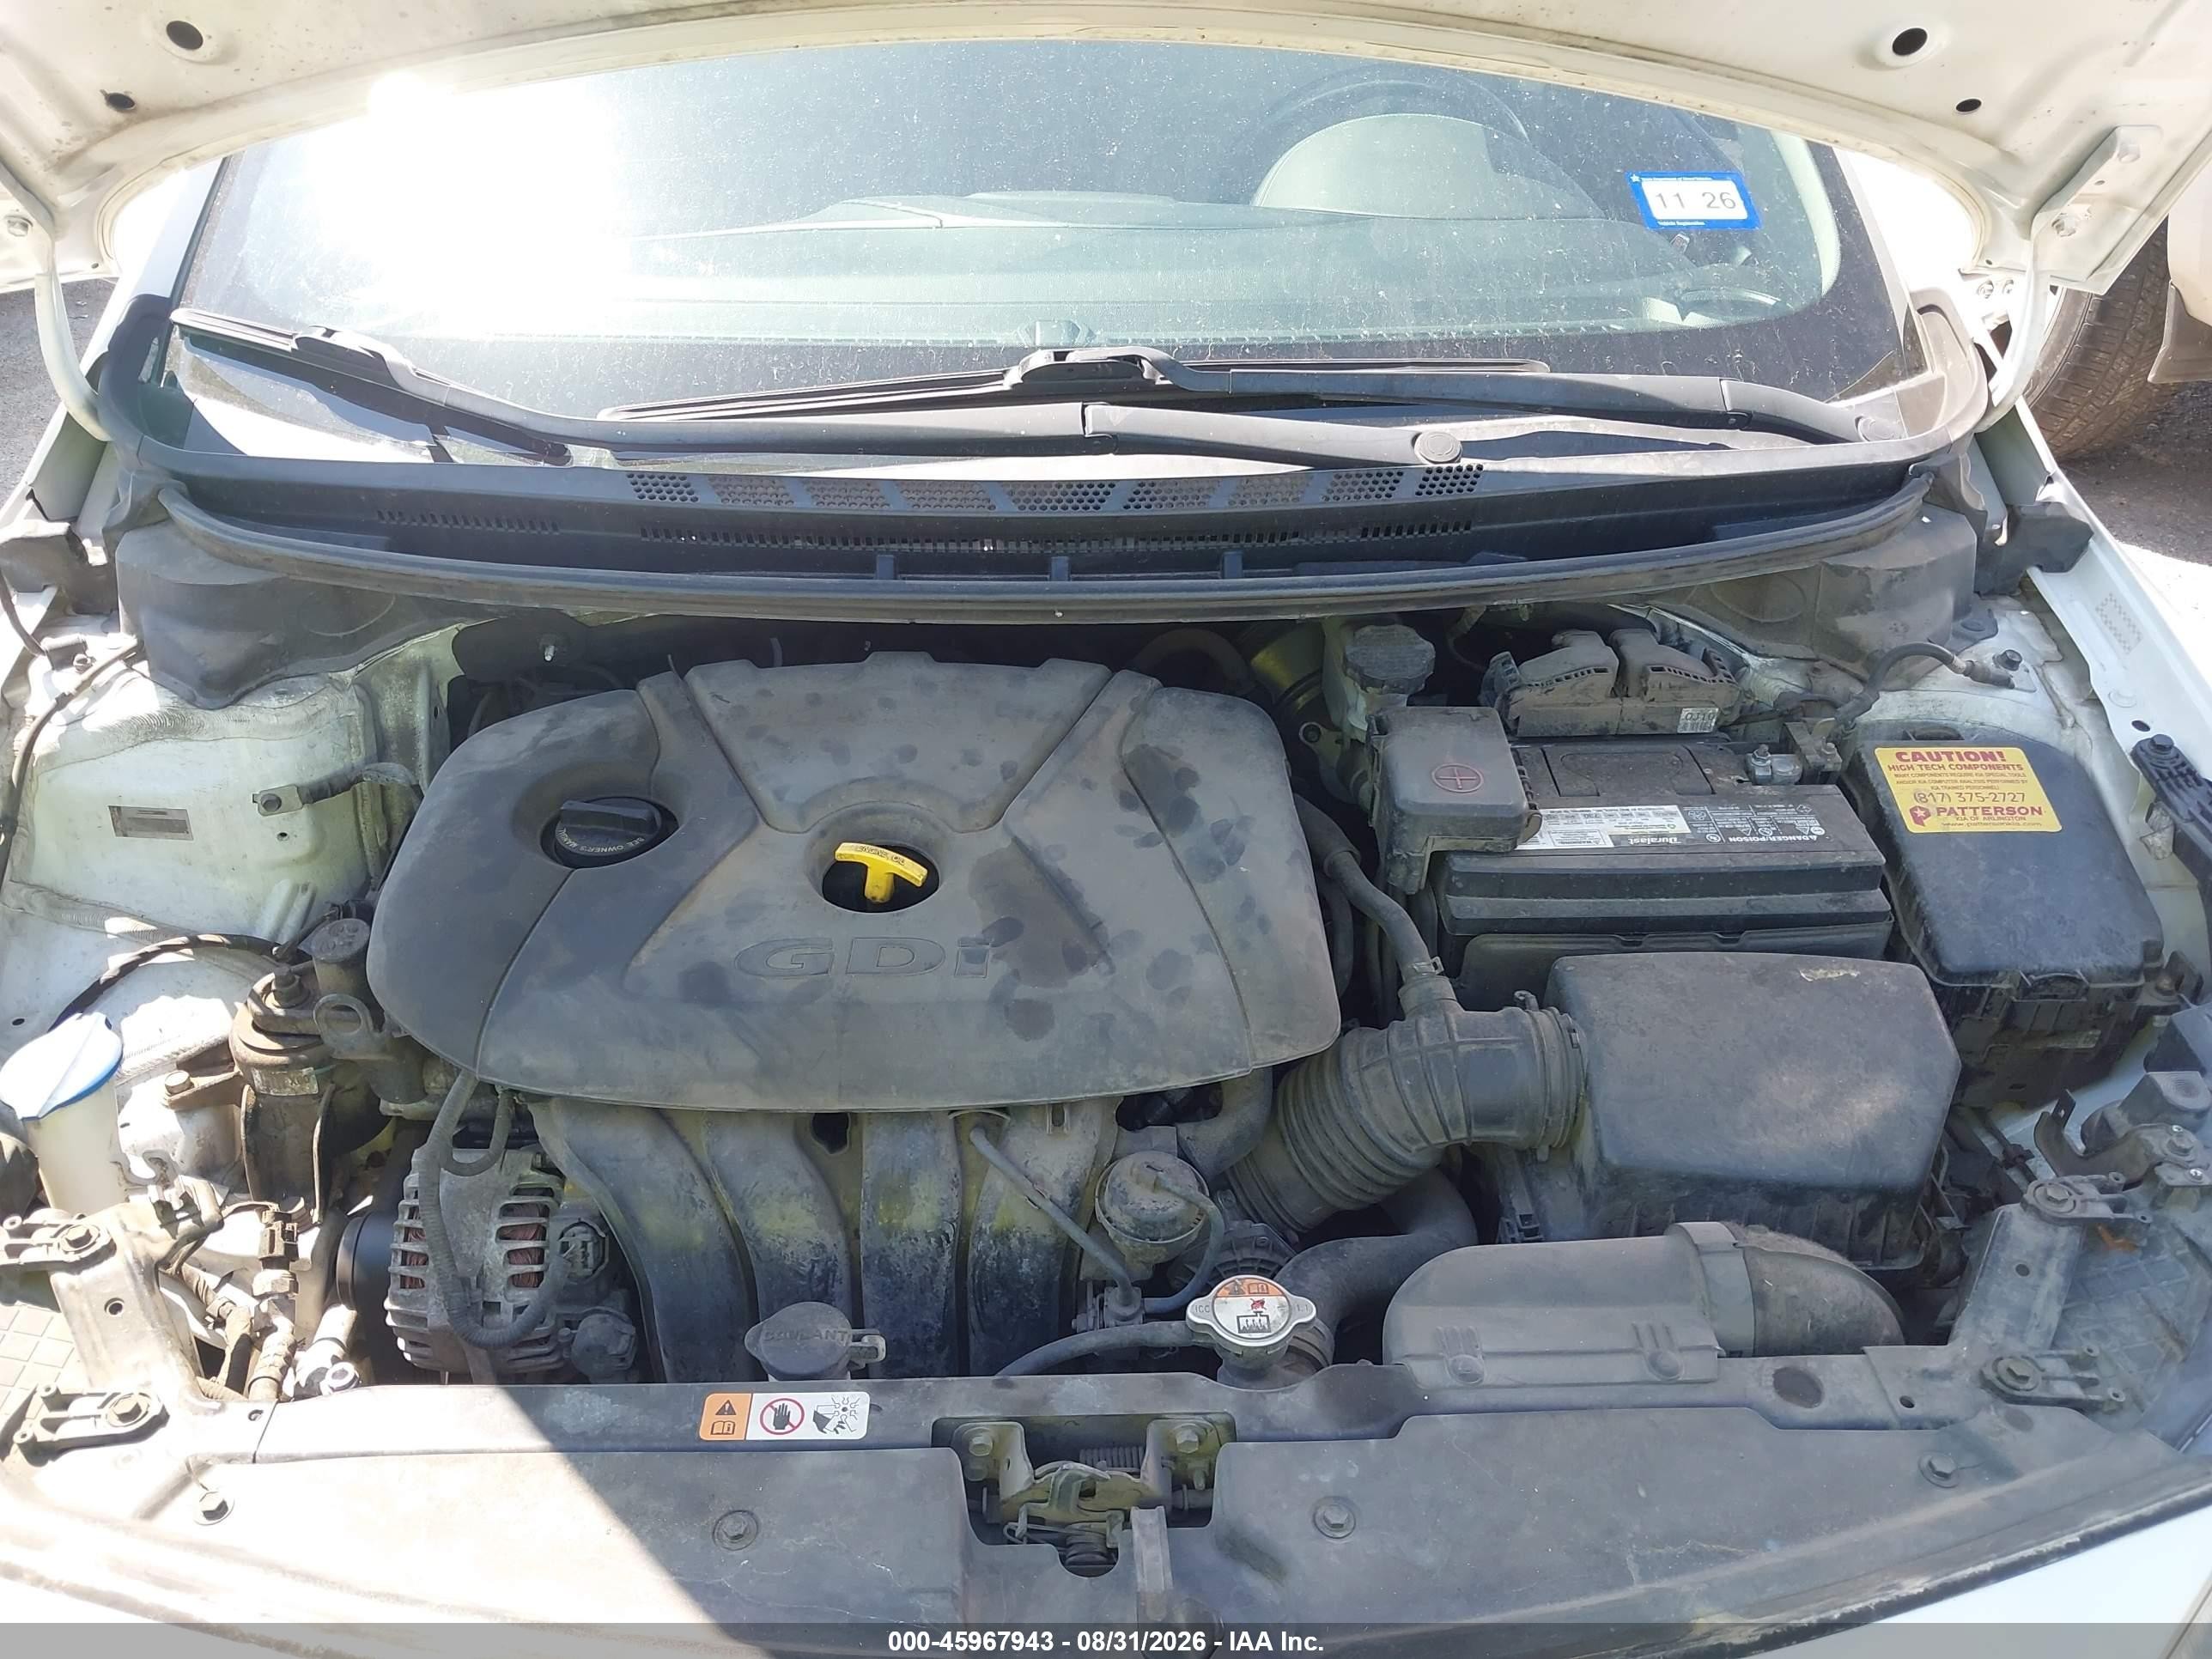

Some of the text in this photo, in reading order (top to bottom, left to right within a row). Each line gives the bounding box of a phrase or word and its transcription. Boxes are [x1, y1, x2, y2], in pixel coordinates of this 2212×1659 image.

[1656, 191, 1736, 210] 11 26
[1895, 750, 2007, 763] CAUTION!
[1914, 792, 2026, 803] (817) 375-2727
[1936, 806, 2043, 816] PATTERSON
[626, 836, 644, 847] SEE
[1628, 836, 1682, 845] Duralast
[763, 1329, 848, 1342] COOLANT
